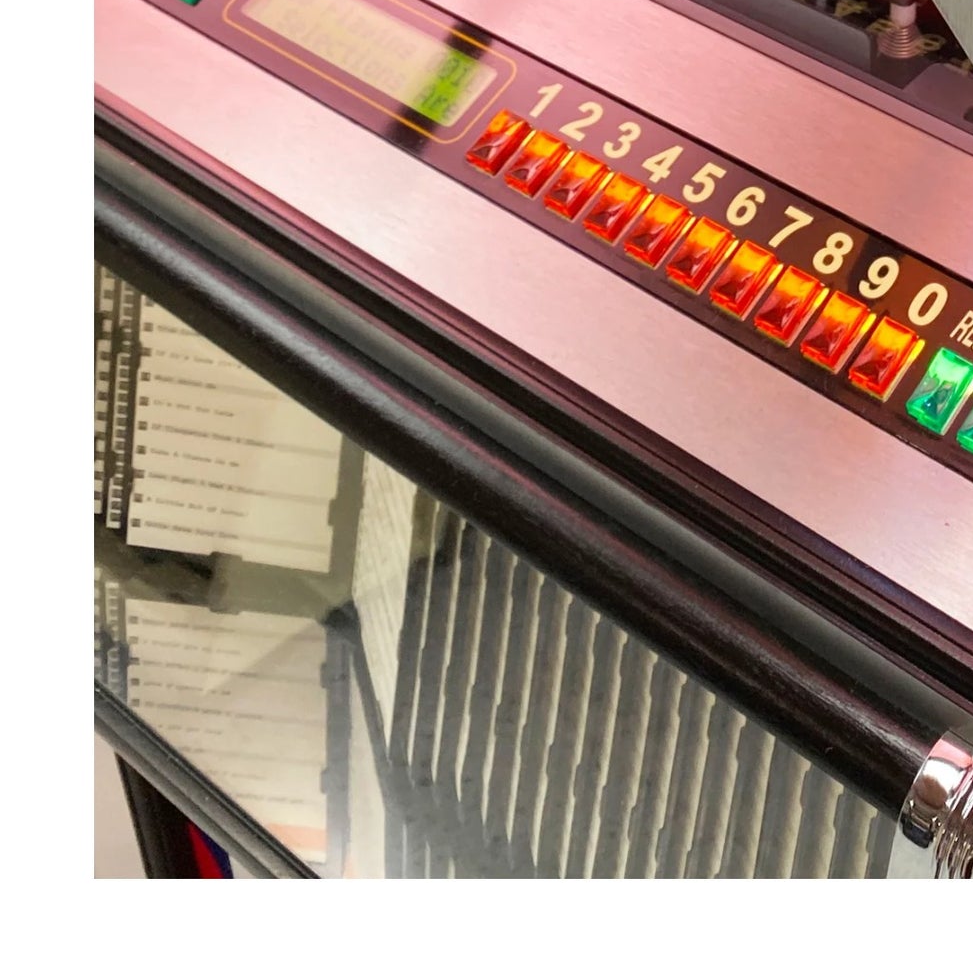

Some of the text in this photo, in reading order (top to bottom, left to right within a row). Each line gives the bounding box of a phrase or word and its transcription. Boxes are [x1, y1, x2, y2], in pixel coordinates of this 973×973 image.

[529, 83, 949, 325] 1 2 3 4 5 6 7 8 9 0
